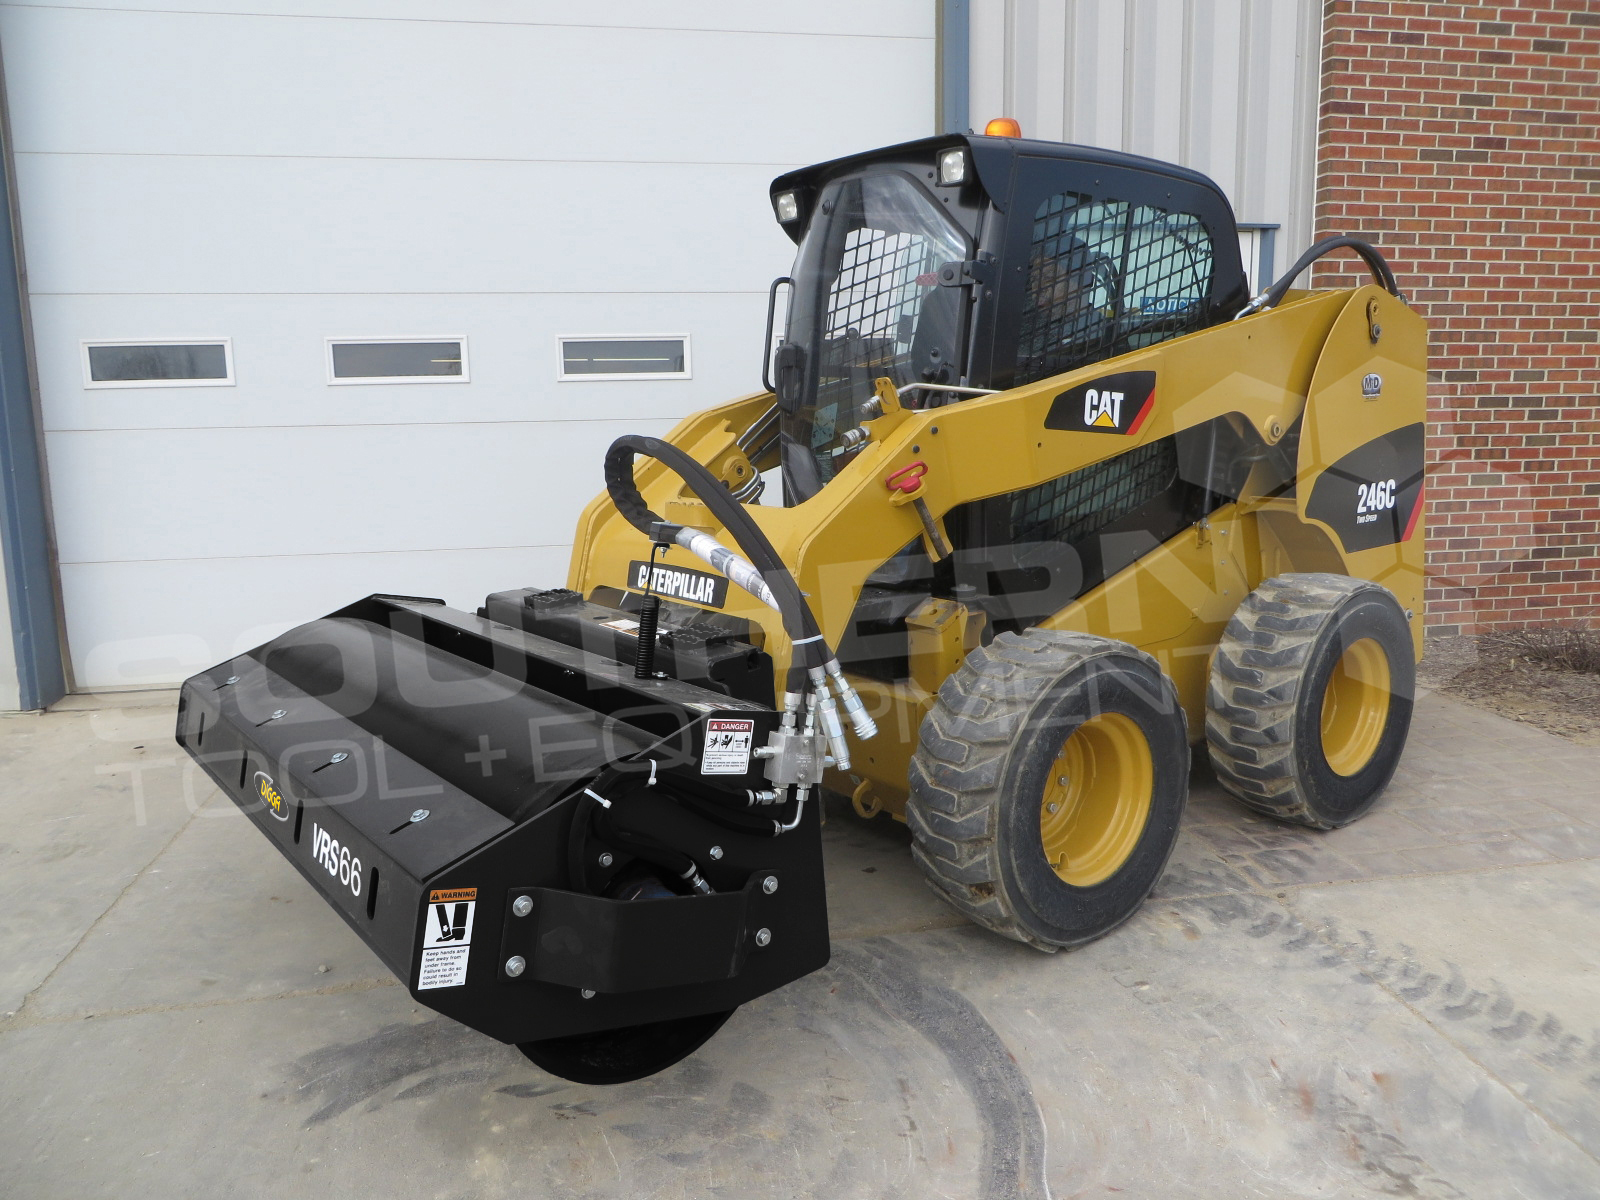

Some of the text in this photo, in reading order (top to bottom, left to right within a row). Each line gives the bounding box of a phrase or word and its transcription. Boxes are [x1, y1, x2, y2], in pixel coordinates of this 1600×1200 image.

[1145, 298, 1196, 311] NOTIC
[1084, 388, 1124, 428] CAT
[1356, 478, 1396, 514] 246C
[637, 564, 715, 604] CATERPILLAR
[312, 822, 362, 897] VRS66
[441, 890, 475, 899] WARNING
